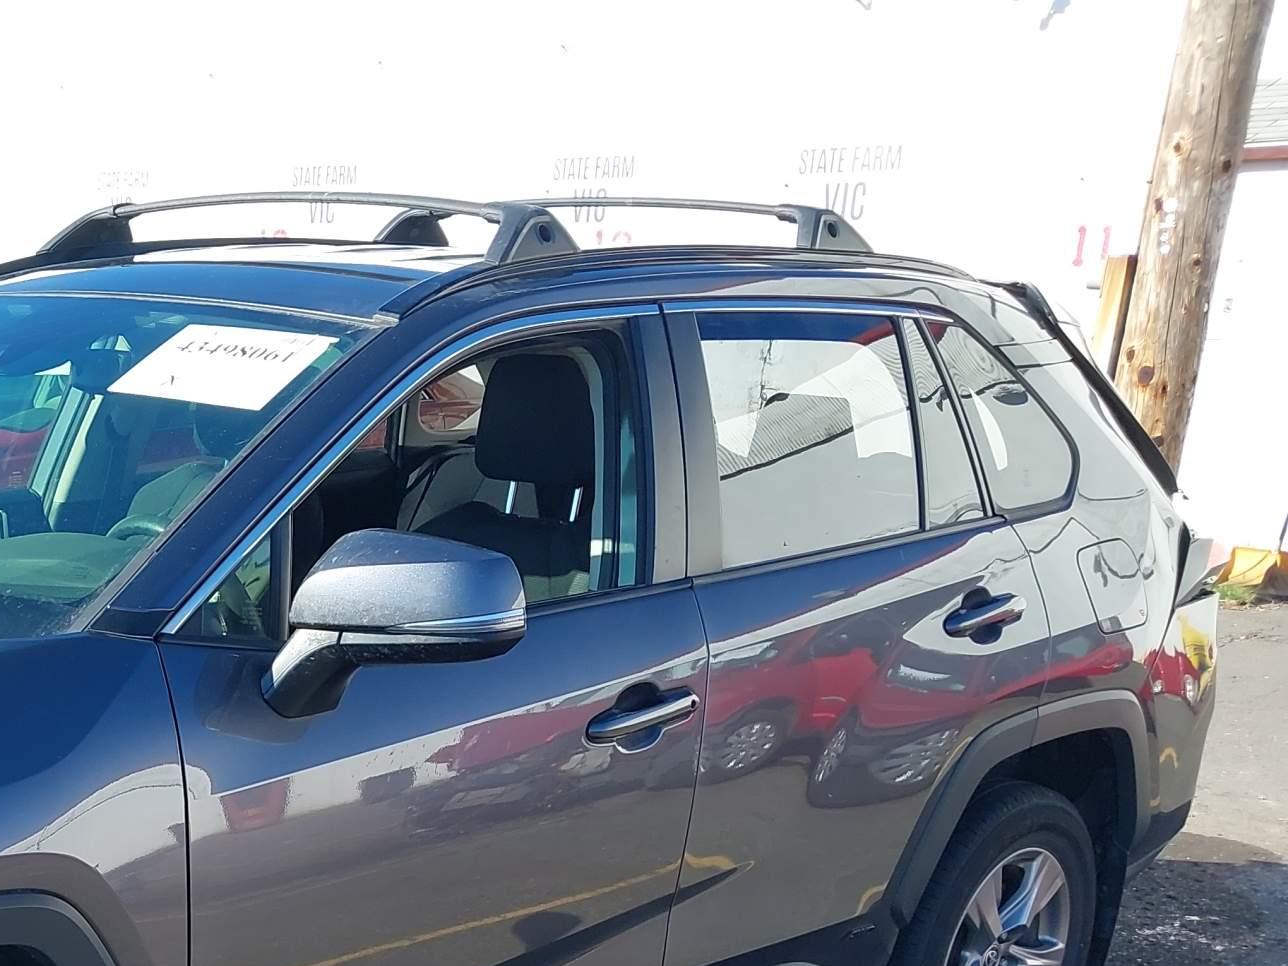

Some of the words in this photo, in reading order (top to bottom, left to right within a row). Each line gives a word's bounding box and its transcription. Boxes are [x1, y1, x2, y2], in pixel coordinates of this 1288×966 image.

[553, 157, 591, 180] STATE
[594, 155, 635, 179] FARM
[799, 147, 848, 174] STATE
[851, 145, 903, 173] FARM
[292, 165, 322, 187] STATE
[325, 164, 358, 185] FARM
[825, 181, 867, 220] VIC
